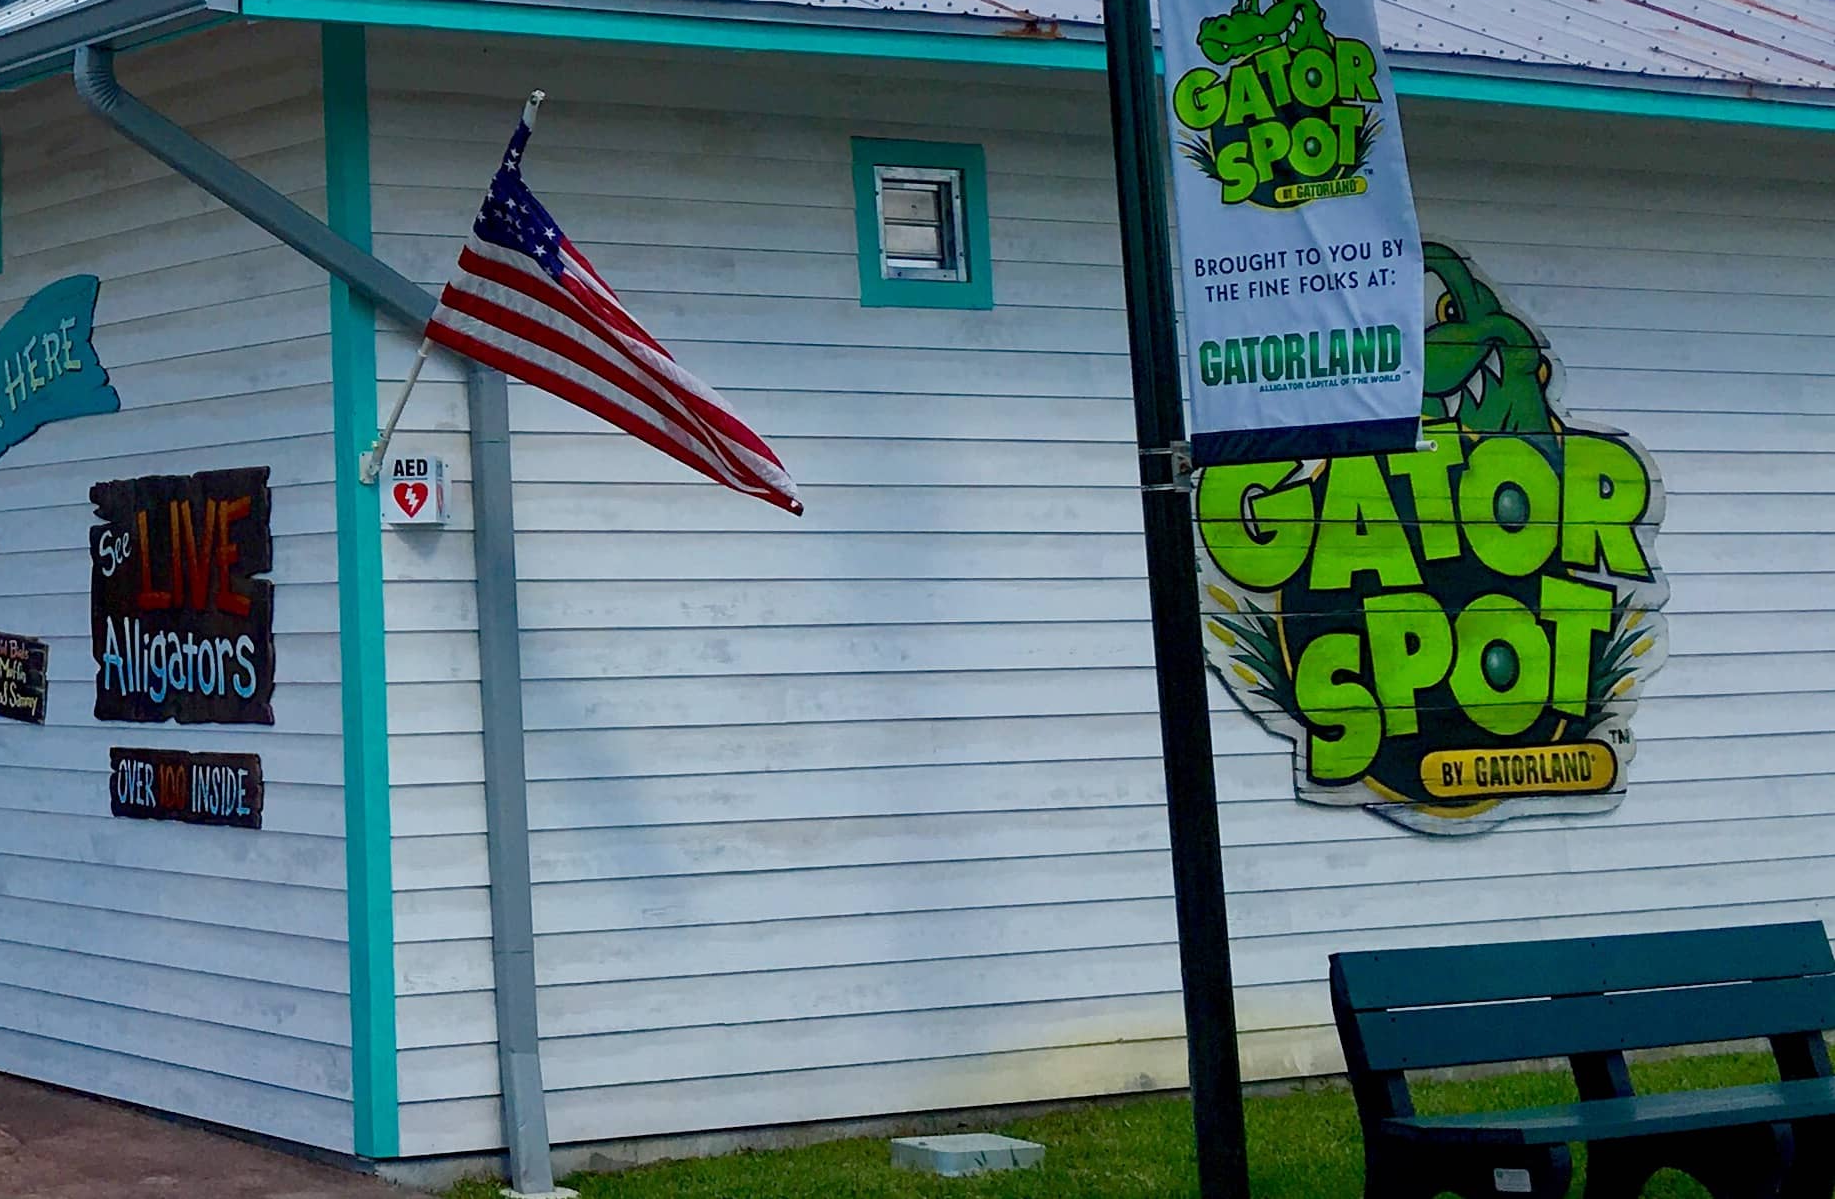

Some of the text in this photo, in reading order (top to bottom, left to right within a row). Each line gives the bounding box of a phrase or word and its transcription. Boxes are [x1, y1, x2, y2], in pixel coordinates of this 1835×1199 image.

[1173, 38, 1383, 130] GATOR
[1216, 104, 1366, 204] SPOT
[1297, 179, 1356, 198] GATORLAND
[1195, 239, 1404, 277] BROUGHT TO YOU BY
[1205, 268, 1396, 302] THE FINE FOLKS AT:
[5, 317, 82, 411] HERE
[1199, 324, 1401, 387] GATORLAND
[1260, 374, 1401, 392] ALLIGATOR CAPITAL OF THE WORLD
[393, 459, 428, 476] AED
[1196, 421, 1655, 592] GATOR
[99, 496, 251, 616] See LIVE
[103, 615, 256, 703] Alligators
[1294, 574, 1618, 786] SPOT
[118, 759, 250, 816] OVER 100 INSIDE
[1442, 752, 1592, 787] BY GATORLAND
